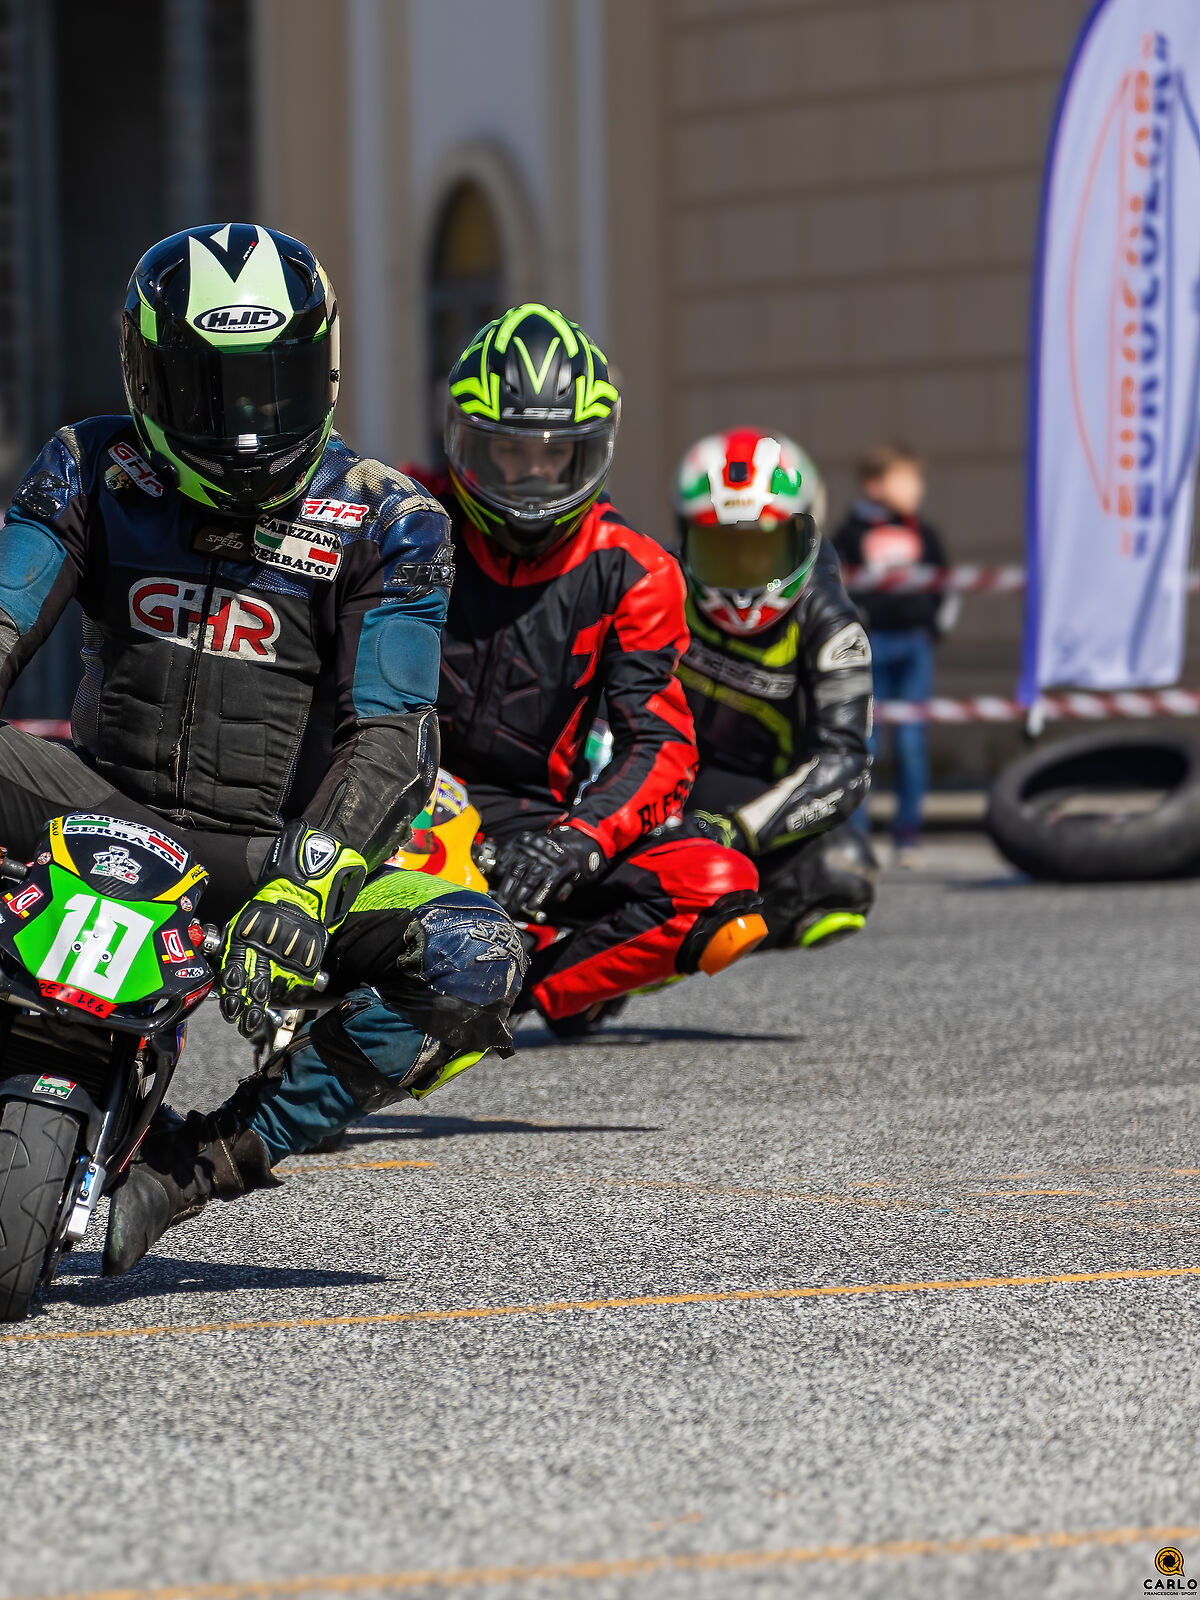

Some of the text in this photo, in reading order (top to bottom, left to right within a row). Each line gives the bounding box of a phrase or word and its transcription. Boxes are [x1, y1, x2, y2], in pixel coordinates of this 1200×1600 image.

[206, 310, 272, 328] HJC
[501, 407, 573, 421] LS2
[205, 534, 244, 550] SPEED
[257, 515, 341, 550] CAREZZANO
[252, 545, 334, 577] SERBATOI
[65, 826, 183, 870] SERBATOI
[69, 814, 187, 856] CAREZZANO
[36, 893, 155, 1001] 10
